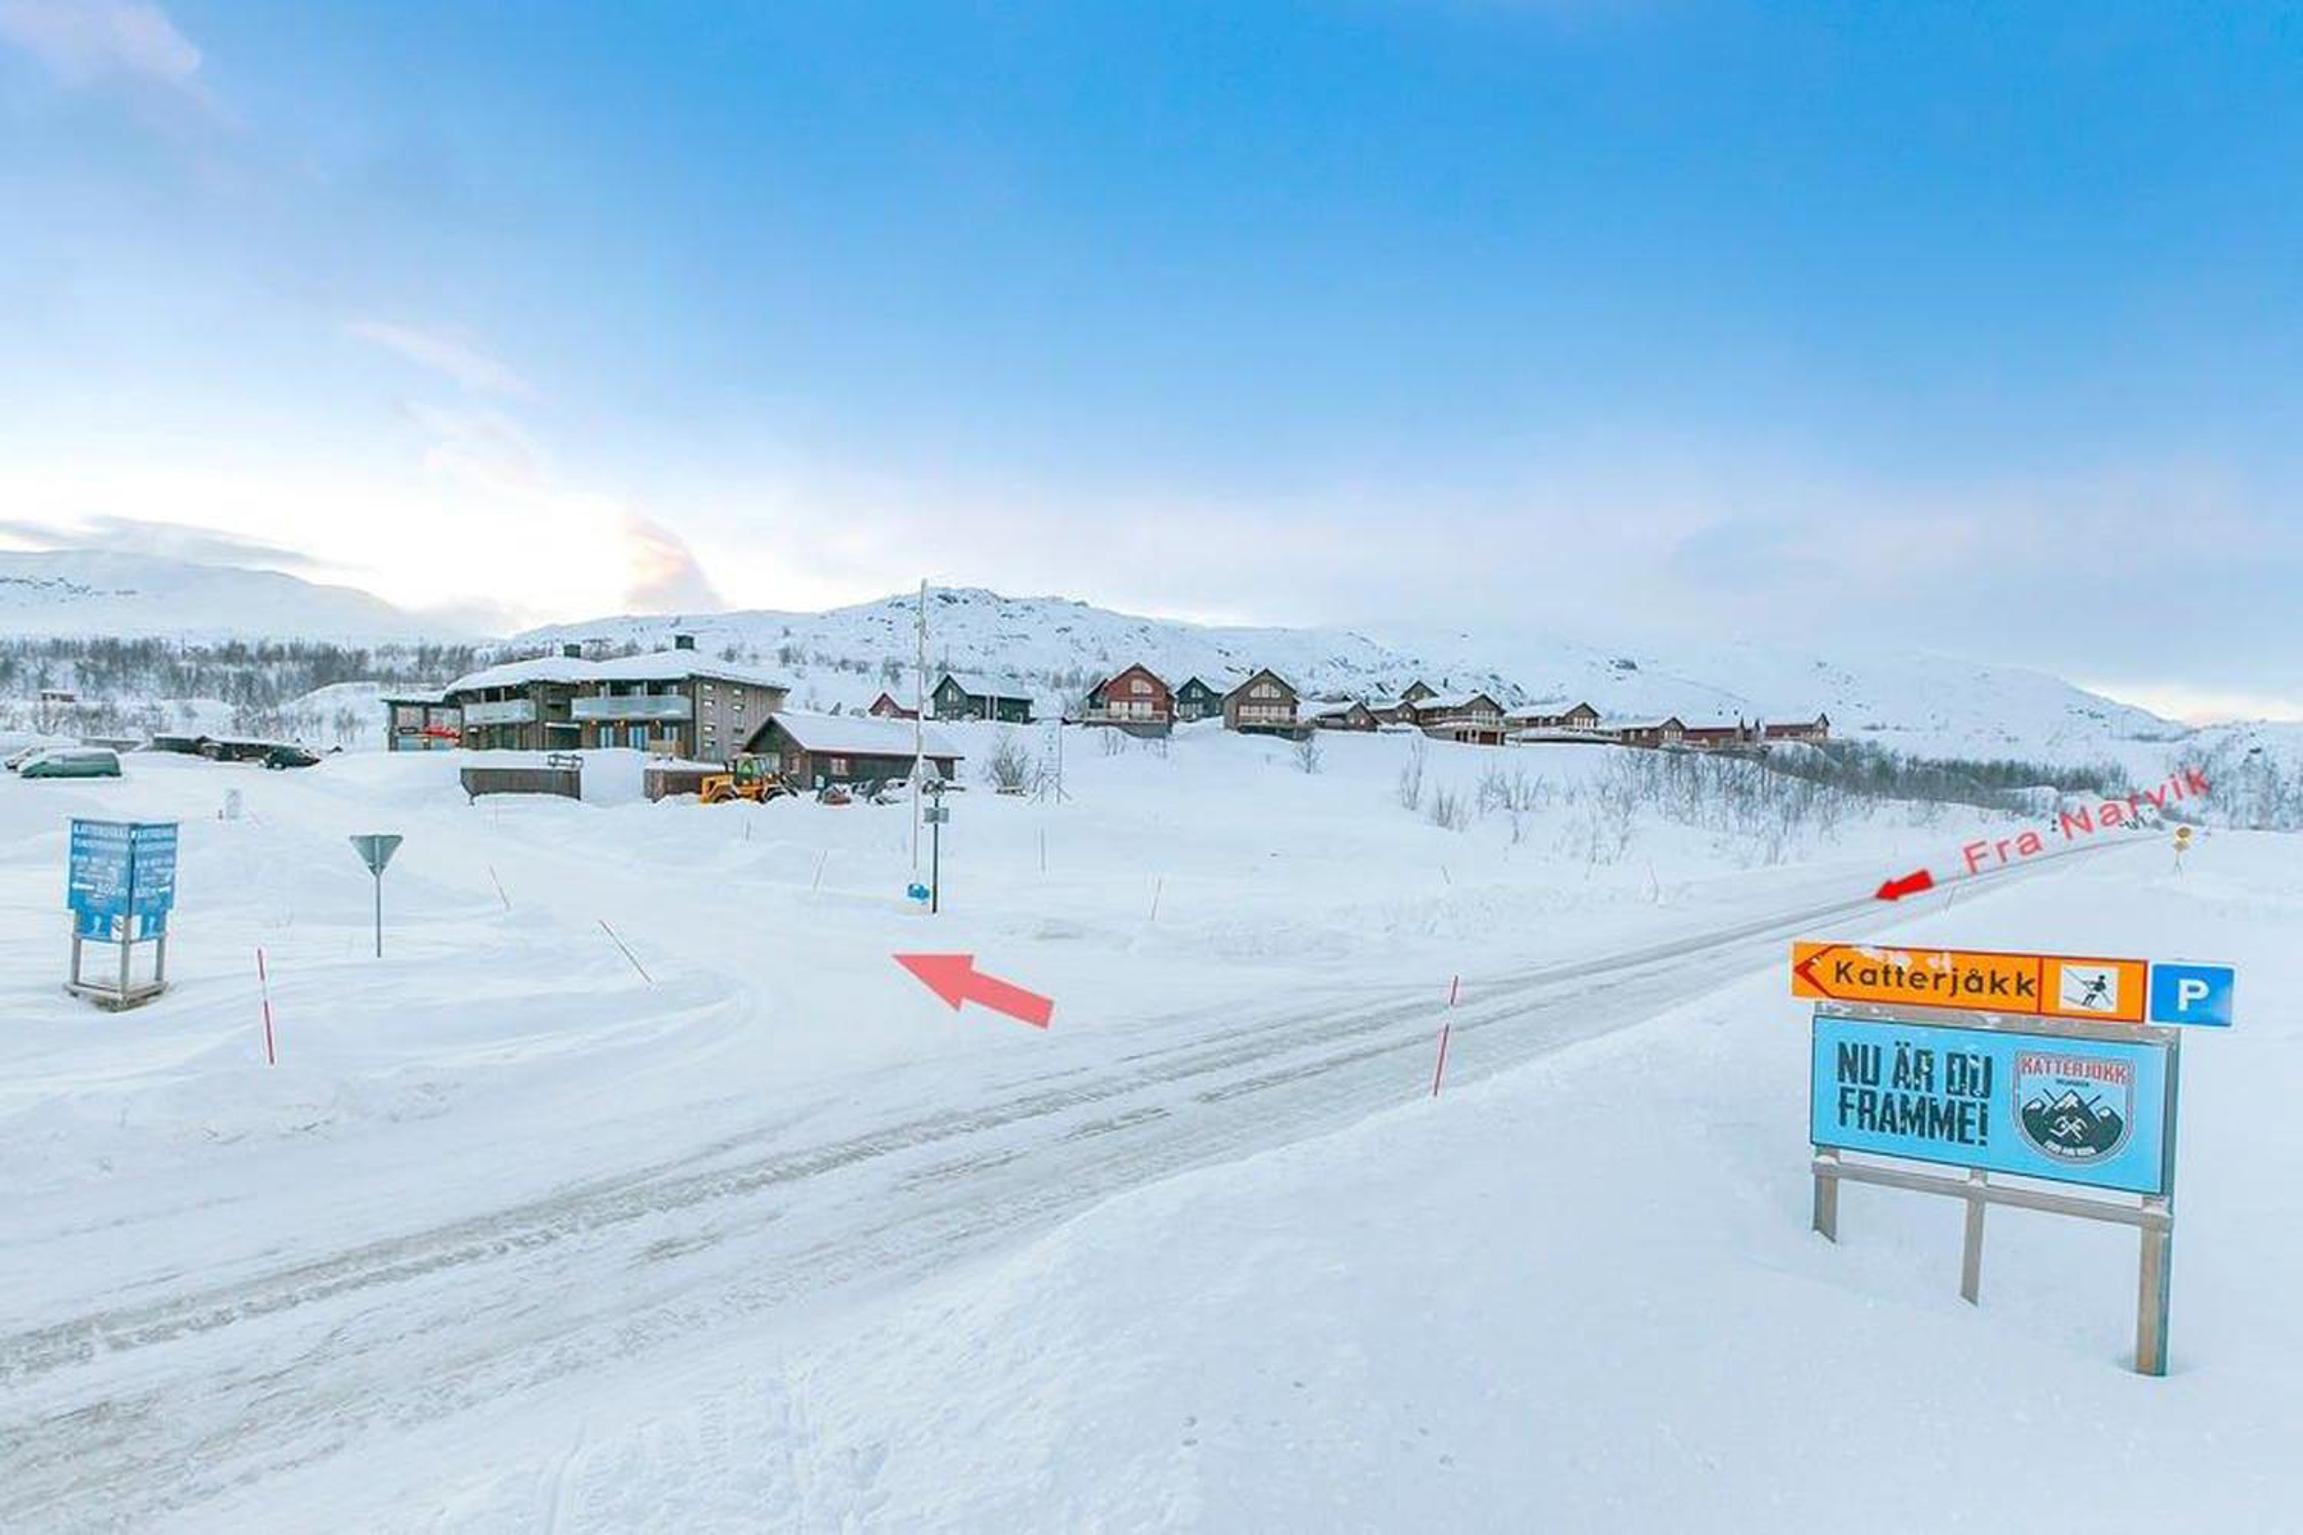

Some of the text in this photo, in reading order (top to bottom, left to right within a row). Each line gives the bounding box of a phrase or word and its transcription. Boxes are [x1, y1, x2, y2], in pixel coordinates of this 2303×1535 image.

[1835, 960, 2035, 997] Katterjåkk
[2178, 979, 2210, 1011] P
[1838, 1040, 1993, 1099] NU ÄR DU
[1838, 1085, 1989, 1146] FRAMME!
